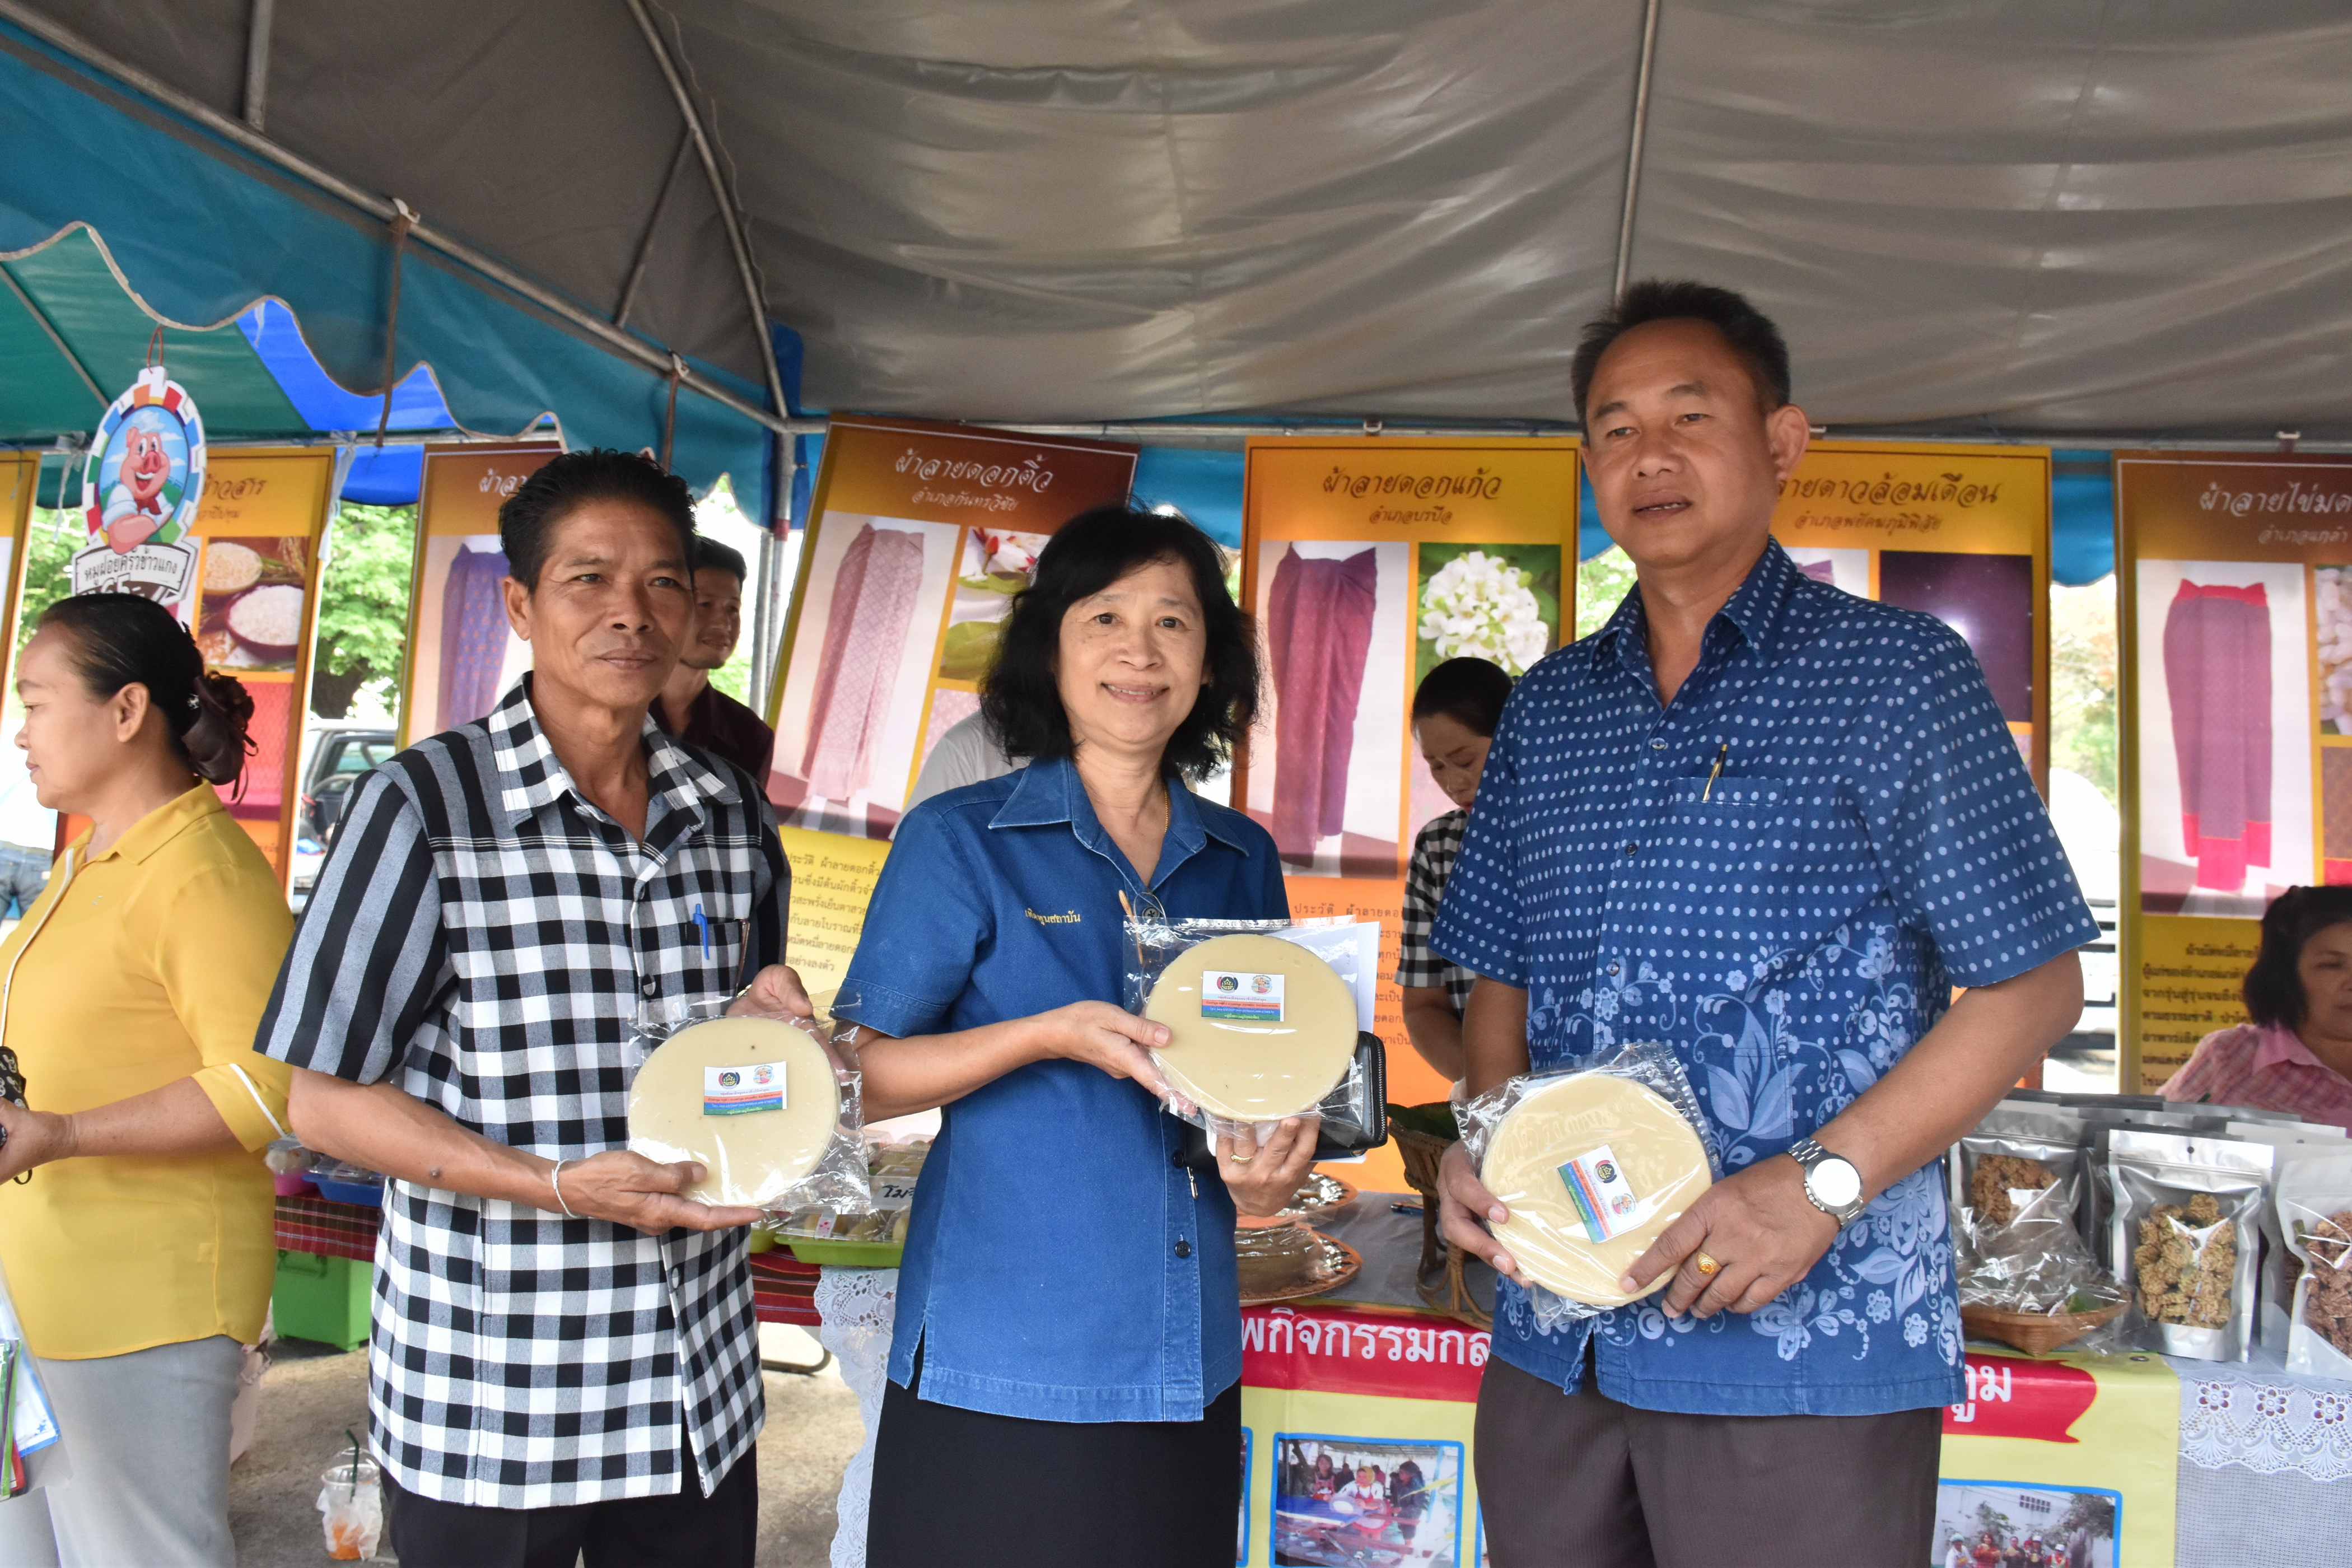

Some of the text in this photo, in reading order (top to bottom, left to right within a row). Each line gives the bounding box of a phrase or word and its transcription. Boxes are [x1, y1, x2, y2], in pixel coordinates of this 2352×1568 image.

[895, 448, 1054, 493] ผ้าลายดอกติ้ว
[1323, 465, 1502, 500] ผ้าลายดอกแก้ว
[1369, 505, 1453, 525] อำเภอบรบือ
[1294, 902, 1335, 914] ประวัติ
